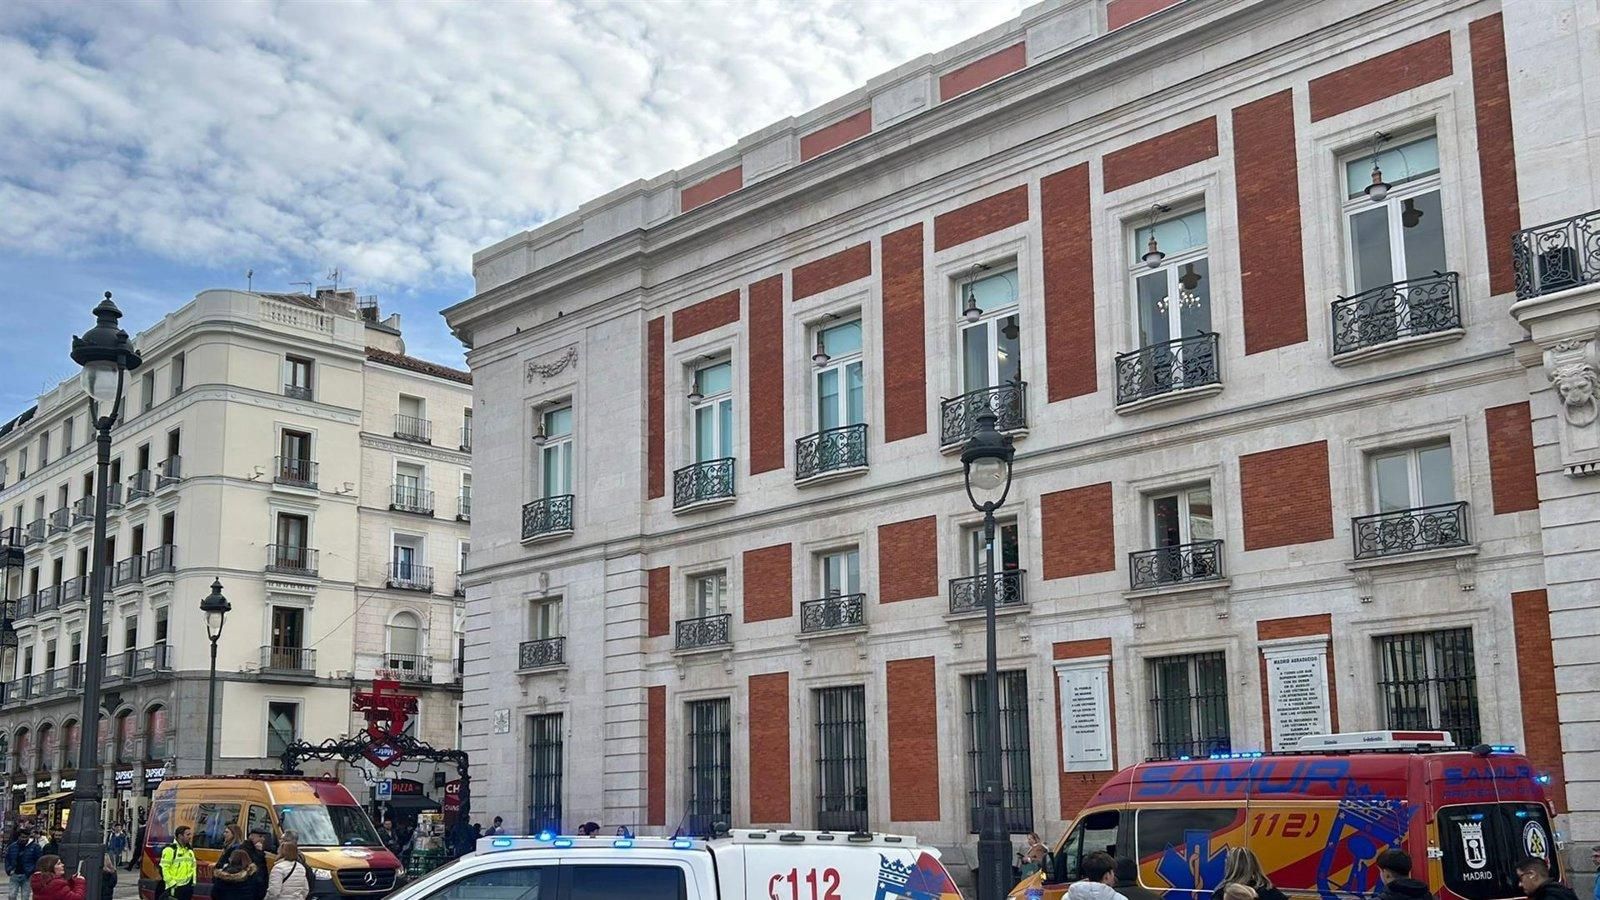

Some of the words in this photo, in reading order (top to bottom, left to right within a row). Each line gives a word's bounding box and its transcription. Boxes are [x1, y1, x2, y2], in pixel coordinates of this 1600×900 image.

[1137, 760, 1352, 796] SAMUR
[1443, 765, 1531, 785] SAMUR
[379, 782, 388, 794] P
[392, 783, 414, 792] PIZZA
[1250, 813, 1307, 838] 112
[787, 867, 841, 900] 112
[1462, 871, 1493, 881] MADRID
